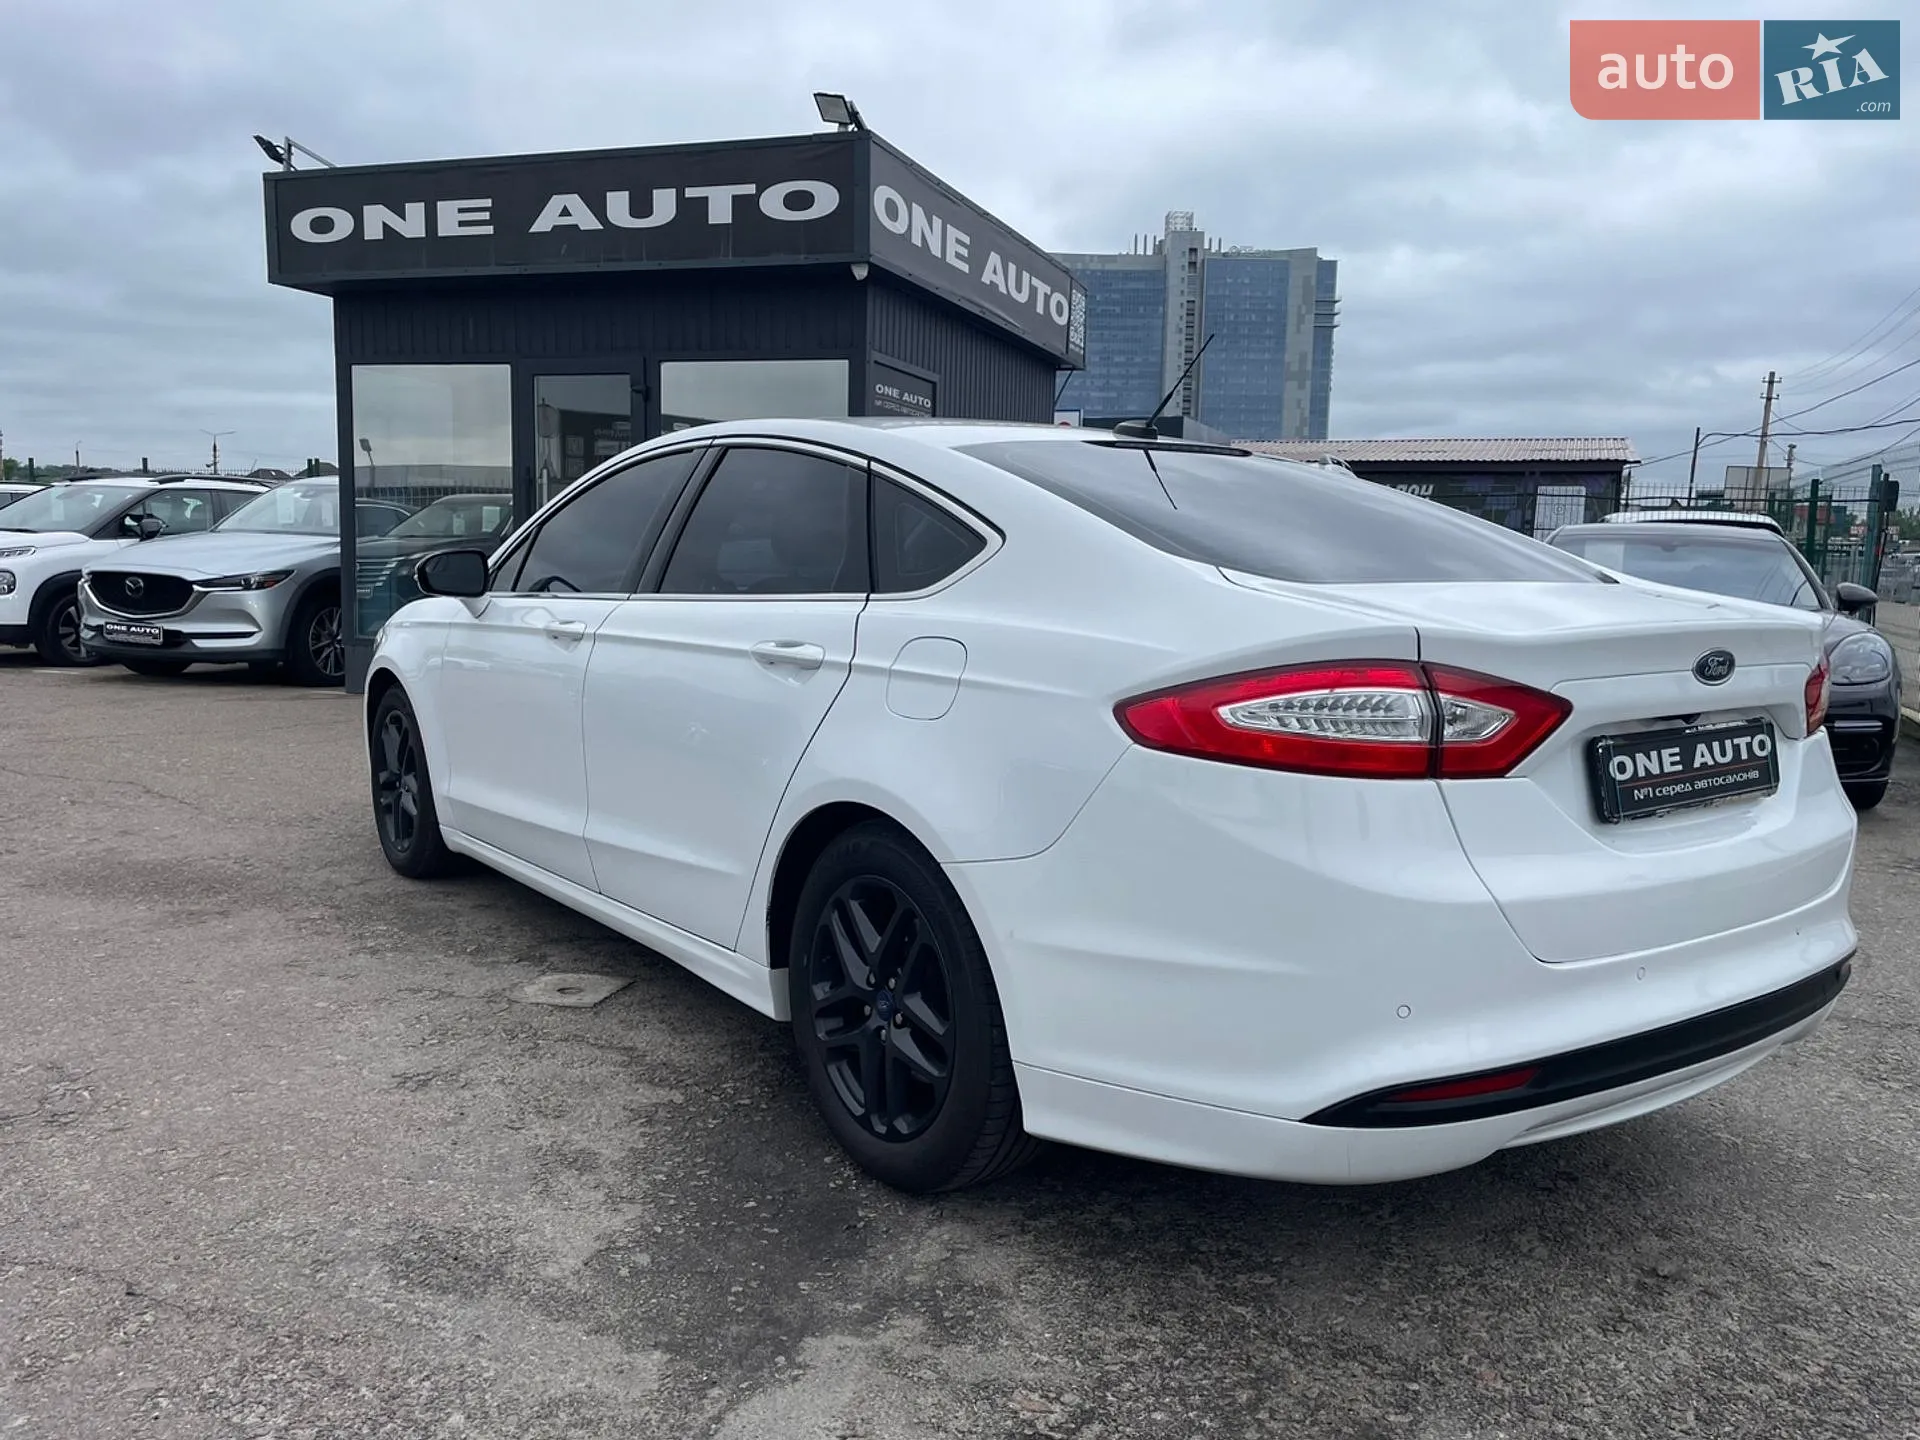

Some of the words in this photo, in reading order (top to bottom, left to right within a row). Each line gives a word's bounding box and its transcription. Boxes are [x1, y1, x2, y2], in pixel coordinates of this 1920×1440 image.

[290, 198, 494, 244] ONE
[528, 180, 840, 233] AUTO
[873, 185, 971, 274] ONE
[981, 251, 1069, 326] AUTO
[875, 383, 900, 399] ONE
[902, 392, 932, 408] AUTO
[130, 626, 159, 634] AUTO
[1609, 747, 1683, 781] ONE
[1693, 733, 1772, 768] AUTO
[1655, 783, 1692, 797] серед
[1694, 769, 1760, 789] автосалонів
